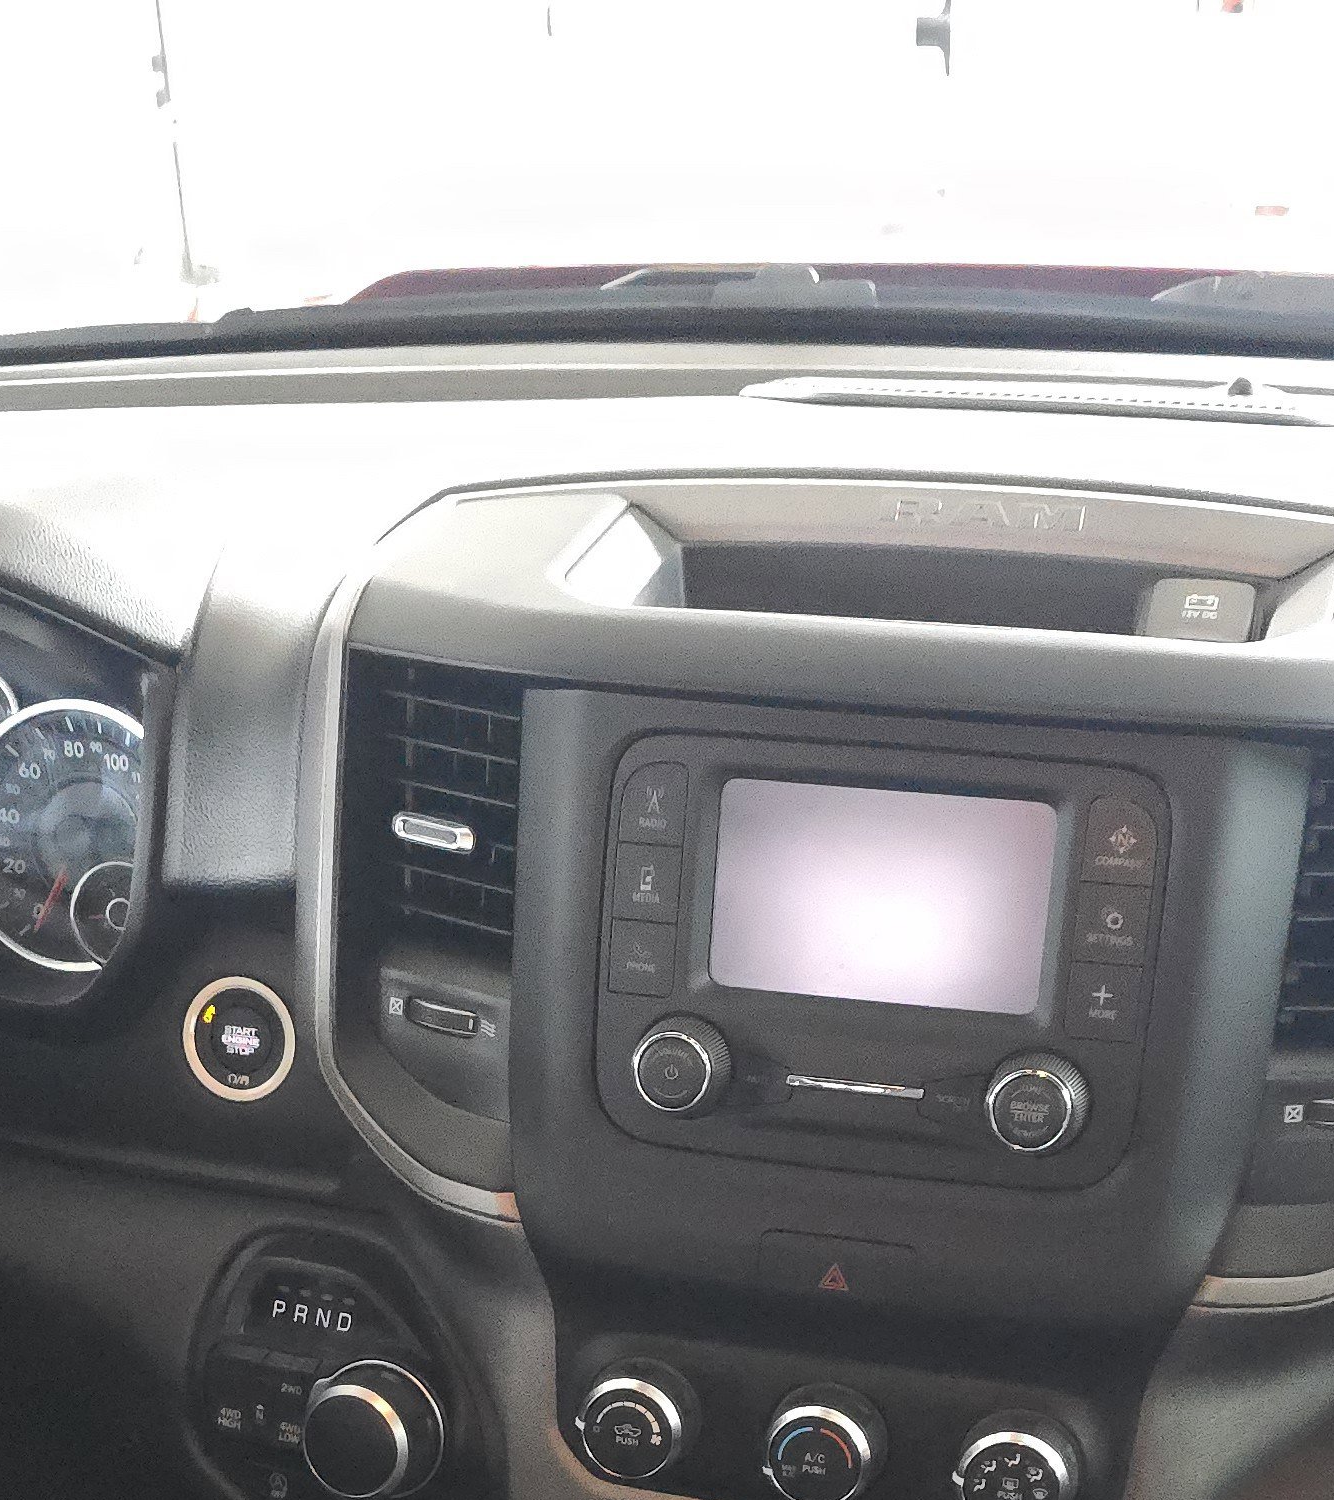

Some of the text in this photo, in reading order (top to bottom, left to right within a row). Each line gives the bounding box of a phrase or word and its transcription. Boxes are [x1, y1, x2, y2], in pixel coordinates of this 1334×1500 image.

[878, 498, 1088, 533] RAM
[63, 740, 85, 759] 80
[103, 753, 129, 772] 100
[18, 762, 41, 780] 60
[638, 815, 668, 830] RADIO
[2, 857, 26, 875] 20
[632, 891, 661, 904] MEDIA
[1088, 1006, 1118, 1021] MORE
[224, 1024, 259, 1037] START
[221, 1033, 261, 1049] ENGINE
[226, 1044, 255, 1056] STOP
[1009, 1100, 1051, 1113] BROWSE
[1013, 1113, 1045, 1123] ENTER
[272, 1299, 353, 1333] P R N D
[280, 1382, 303, 1396] 2WD
[219, 1406, 242, 1420] 4WD
[216, 1416, 242, 1431] HIGH
[278, 1431, 300, 1444] LOW
[615, 1434, 640, 1447] PUSH
[804, 1452, 826, 1464] A/C
[801, 1464, 827, 1476] PUSH
